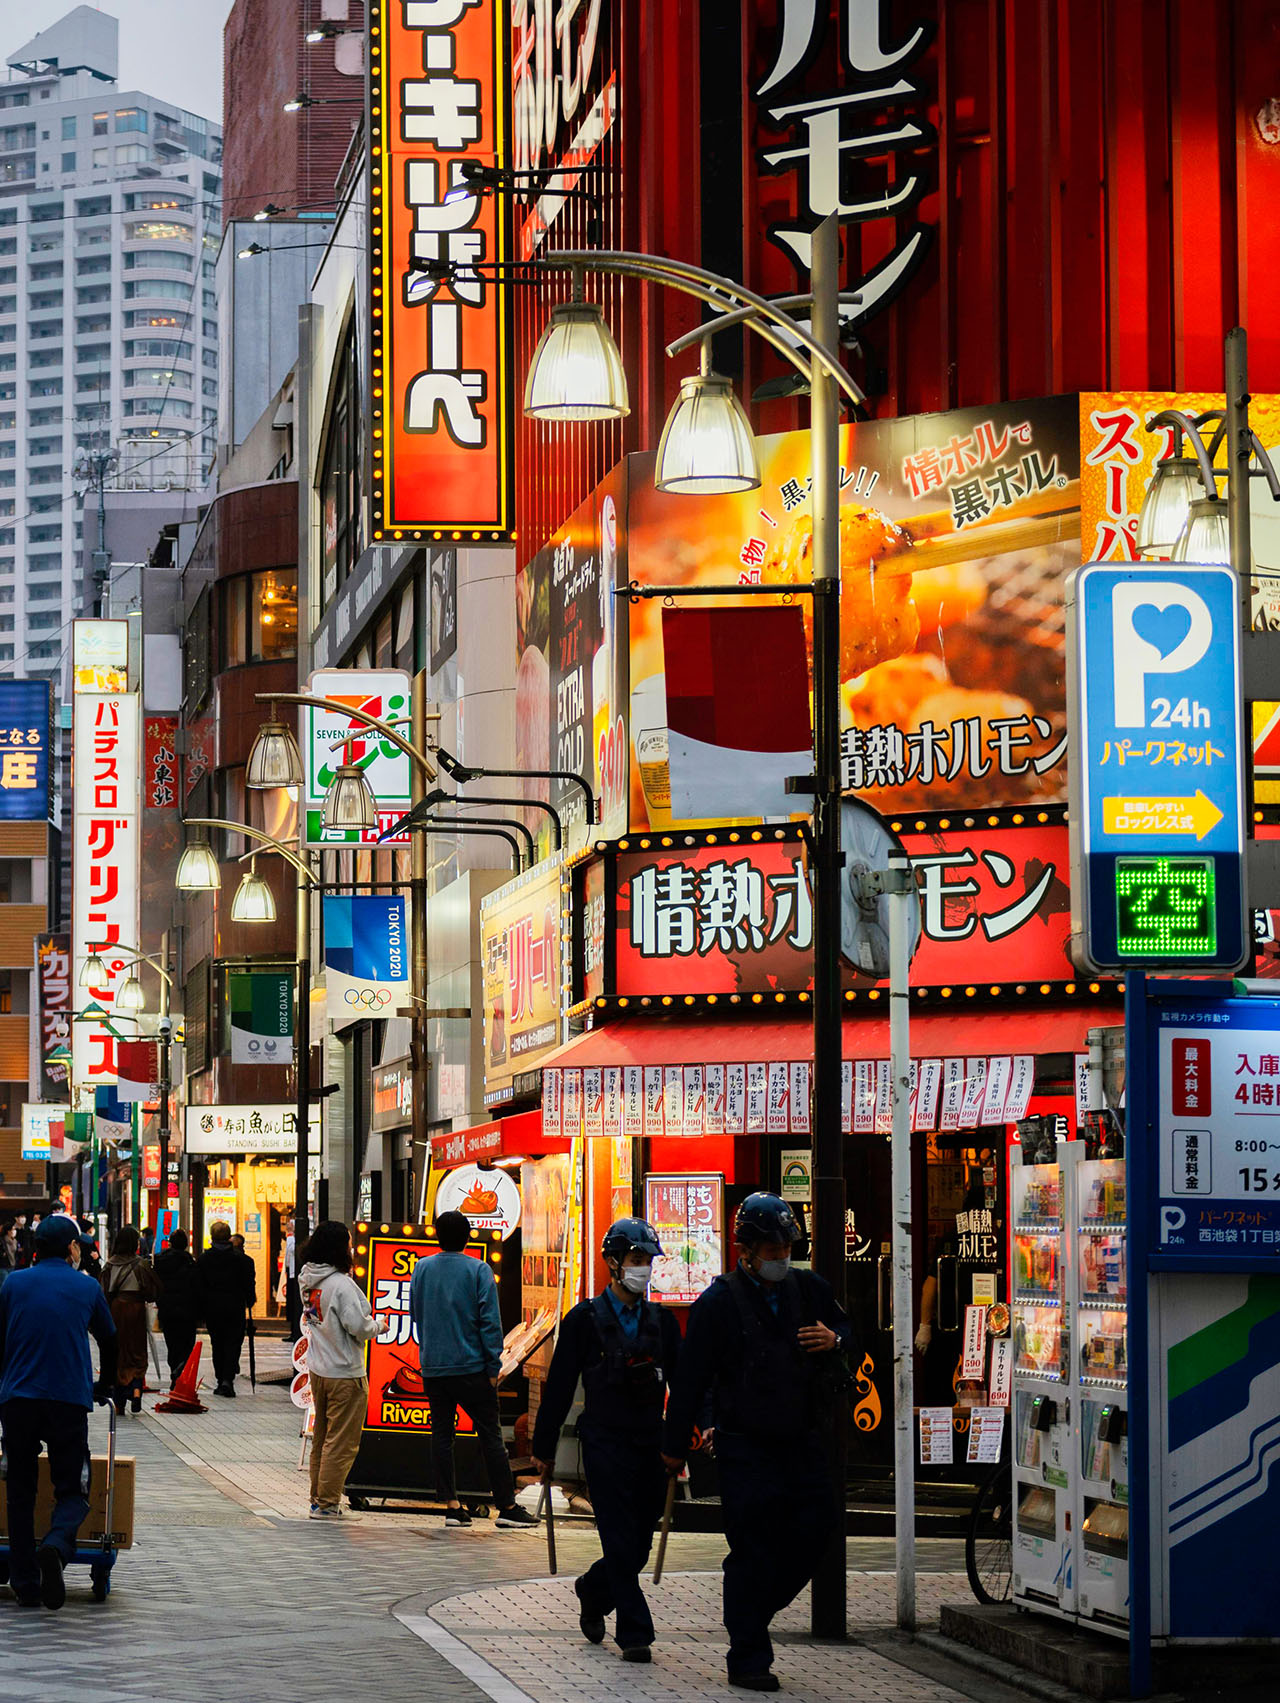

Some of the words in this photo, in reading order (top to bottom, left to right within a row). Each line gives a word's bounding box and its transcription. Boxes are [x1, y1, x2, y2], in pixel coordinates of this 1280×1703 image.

[903, 421, 1031, 497] 情ホルで
[1113, 582, 1213, 728] P
[557, 664, 584, 735] EXTRA
[1150, 697, 1211, 728] 24h
[316, 730, 346, 739] SEVEN
[94, 701, 119, 808] パチスロ
[557, 724, 584, 792] COLD
[838, 716, 1070, 789] 情熱ホルモン
[1100, 740, 1224, 766] パークネット
[154, 746, 174, 805] 小東北
[1115, 816, 1194, 830] ロックレス式
[632, 847, 1057, 958] 情熱ホモン
[1116, 859, 1213, 953] 空
[388, 905, 400, 947] TOKYO
[390, 949, 402, 978] 2020
[42, 953, 70, 1050] カラオケ
[279, 979, 287, 1007] TOKYO
[280, 1009, 288, 1034] 2020
[1161, 1012, 1231, 1024] 監視カメラ作動中
[1184, 1047, 1199, 1109] 最大料金
[1234, 1082, 1280, 1107] 4時
[769, 1116, 786, 1124] 990
[791, 1116, 807, 1124] 990
[917, 1112, 933, 1120] 690
[943, 1112, 958, 1120] 790
[961, 1110, 977, 1118] 990
[227, 1139, 258, 1148] STANDING
[261, 1139, 280, 1148] SUSHI
[283, 1139, 296, 1147] BAR
[1185, 1135, 1199, 1190] 通常料金
[697, 1185, 713, 1243] もつ鍋
[969, 1209, 993, 1234] 情熱
[1199, 1209, 1267, 1225] パークネット
[1169, 1236, 1185, 1245] 24h
[965, 1359, 981, 1368] 590
[997, 1341, 1006, 1385] 炙り牛カルビ
[990, 1391, 1007, 1400] 690
